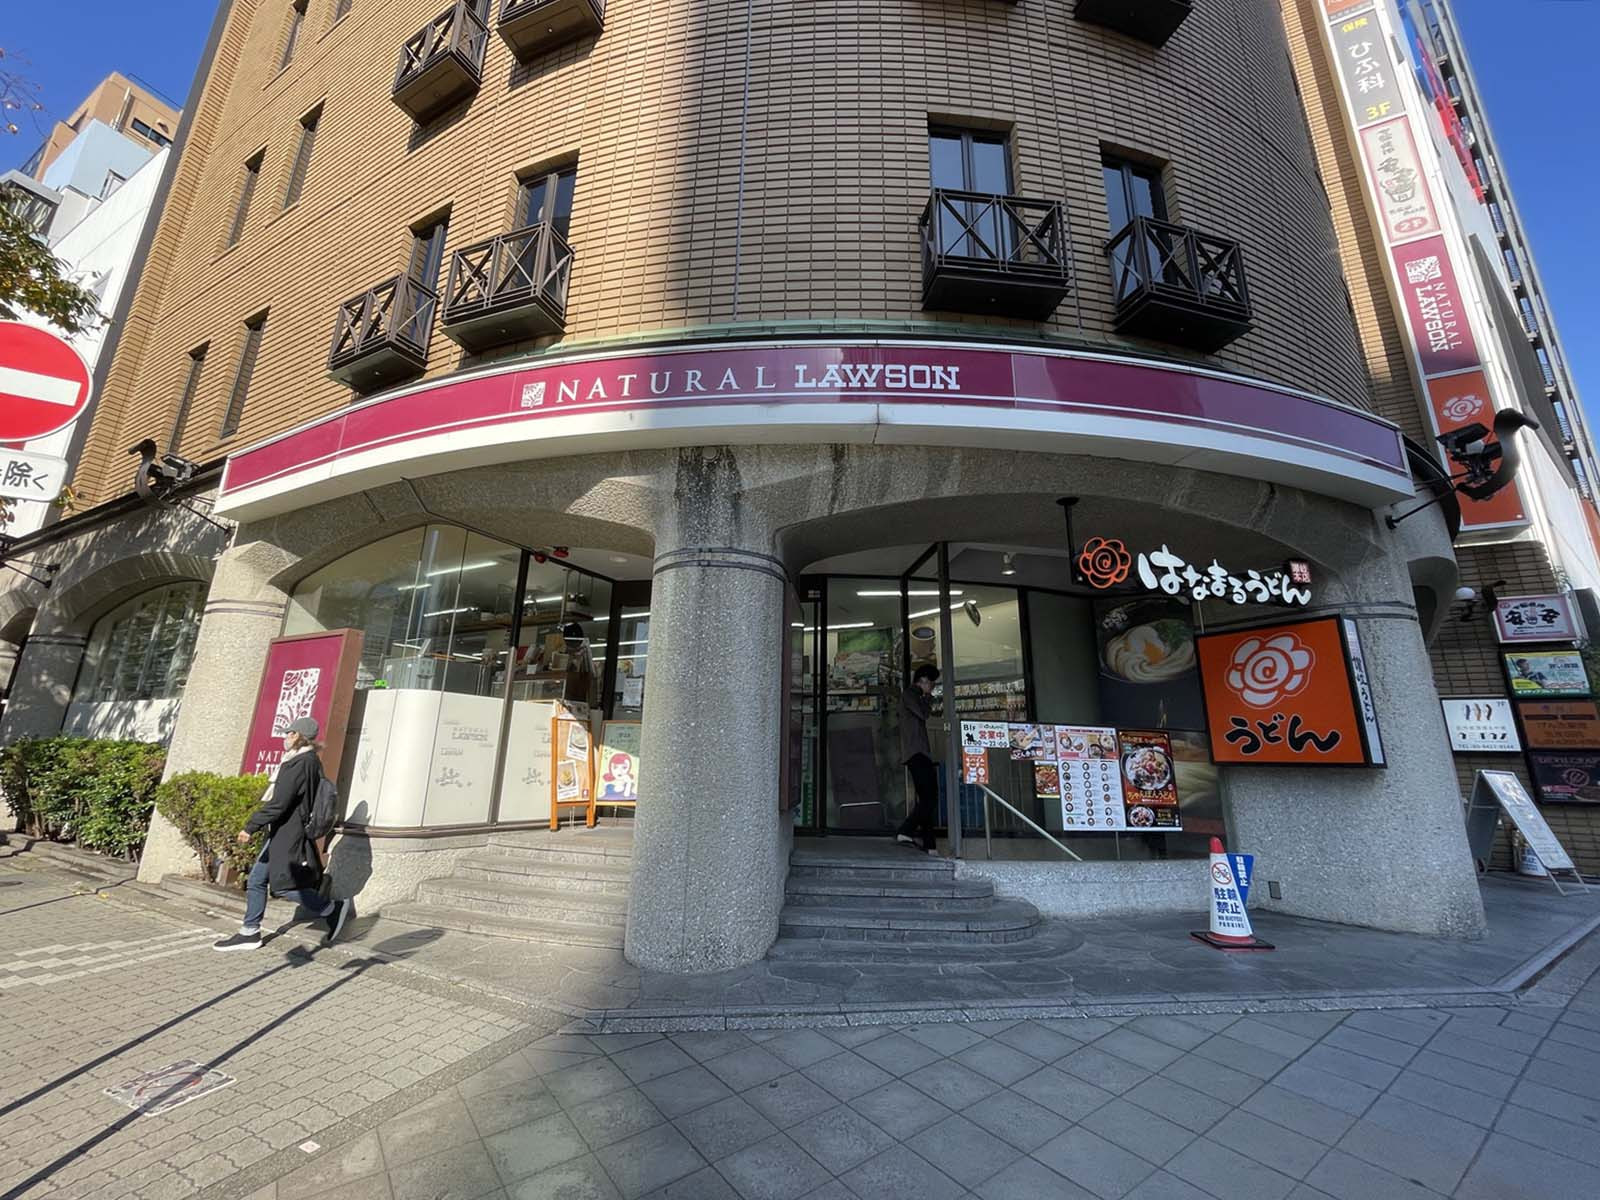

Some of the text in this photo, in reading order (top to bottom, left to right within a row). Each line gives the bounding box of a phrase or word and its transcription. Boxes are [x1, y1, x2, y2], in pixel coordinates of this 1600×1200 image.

[1349, 41, 1385, 94] ひふ科
[1366, 101, 1392, 120] 3F
[1415, 284, 1449, 352] LAWSON
[1433, 282, 1462, 350] NATURAL
[557, 363, 961, 403] NATURAL LAWSON
[1137, 543, 1312, 605] はなまるうどん
[979, 730, 1005, 740] 営業中
[1224, 711, 1342, 756] うどん
[1214, 887, 1238, 901] 駐輪
[1216, 901, 1241, 914] 禁止
